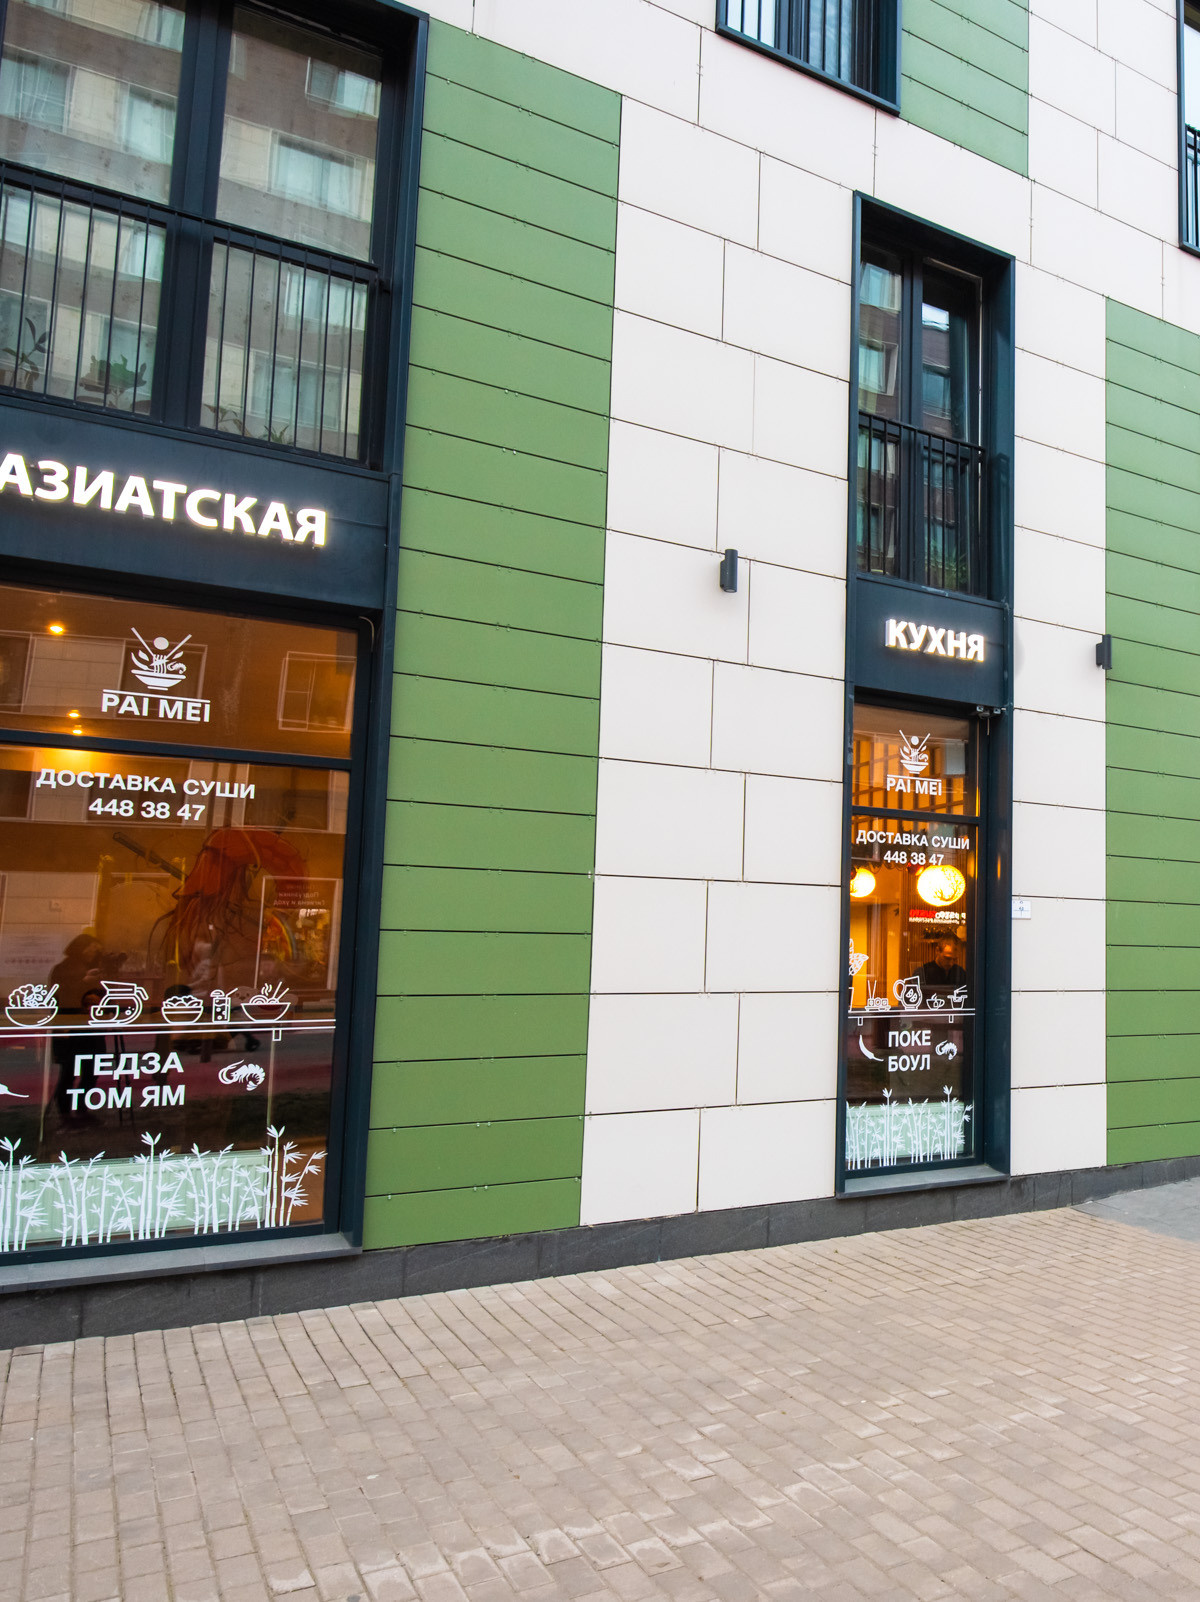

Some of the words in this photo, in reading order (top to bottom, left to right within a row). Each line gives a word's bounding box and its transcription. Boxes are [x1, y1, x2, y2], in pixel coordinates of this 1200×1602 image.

[0, 453, 328, 547] АЗИАТСКАЯ
[884, 619, 985, 662] КУХНЯ
[101, 692, 150, 718] PAI
[157, 699, 211, 723] MEI
[36, 768, 177, 795] ДОСТАВКА
[183, 779, 256, 800] СУШИ
[886, 777, 911, 793] PAI
[915, 780, 942, 796] MEI
[88, 797, 135, 818] 448
[140, 801, 170, 820] 38
[176, 803, 206, 822] 47
[856, 829, 929, 847] ДОСТАВКА
[931, 834, 970, 850] СУШИ
[883, 850, 907, 864] 448
[910, 852, 926, 866] 38
[928, 853, 945, 866] 47
[887, 1030, 931, 1048] ПОКЕ
[74, 1052, 184, 1080] ГЕДЗА
[887, 1054, 931, 1072] БОУЛ
[66, 1086, 132, 1111] ТОМ
[140, 1085, 185, 1107] ЯМ
